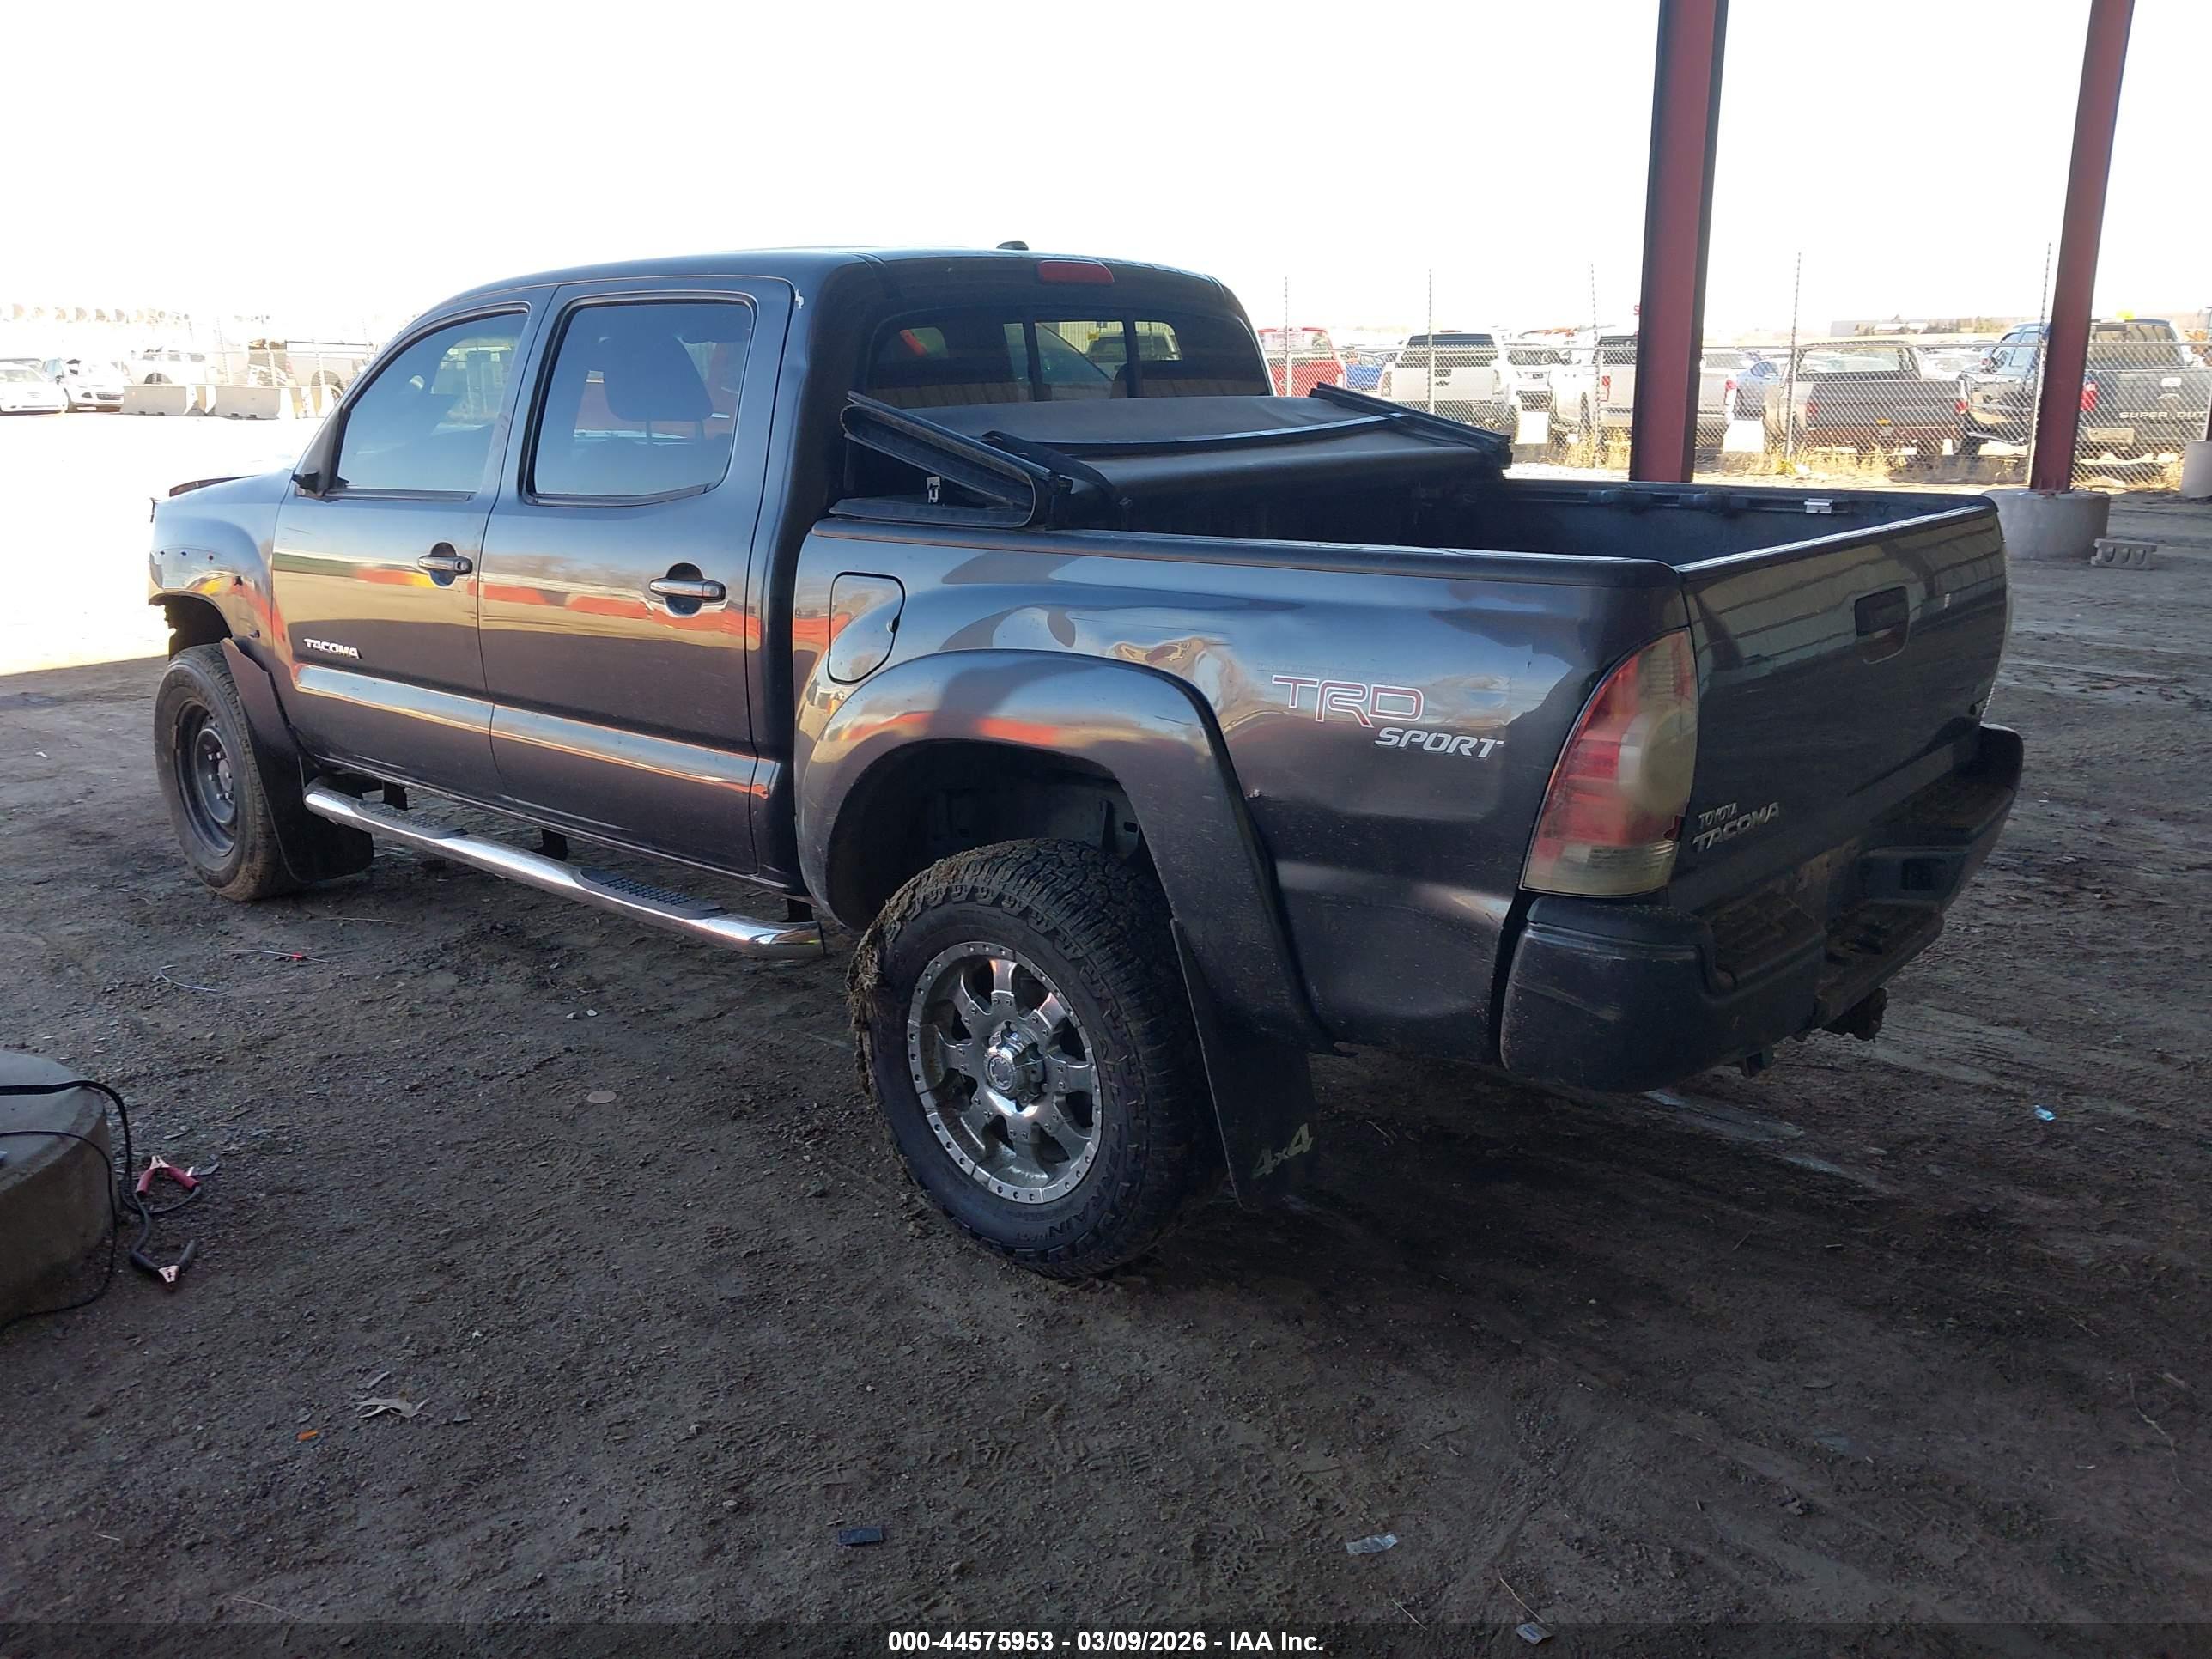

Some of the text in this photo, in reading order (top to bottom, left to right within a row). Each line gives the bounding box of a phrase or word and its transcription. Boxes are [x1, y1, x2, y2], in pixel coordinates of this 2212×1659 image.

[303, 638, 360, 659] TACOMA
[1271, 674, 1425, 729] TRD
[1375, 726, 1504, 758] SPORT
[1692, 801, 1780, 852] TACOMA
[1698, 802, 1738, 830] TOYOTA
